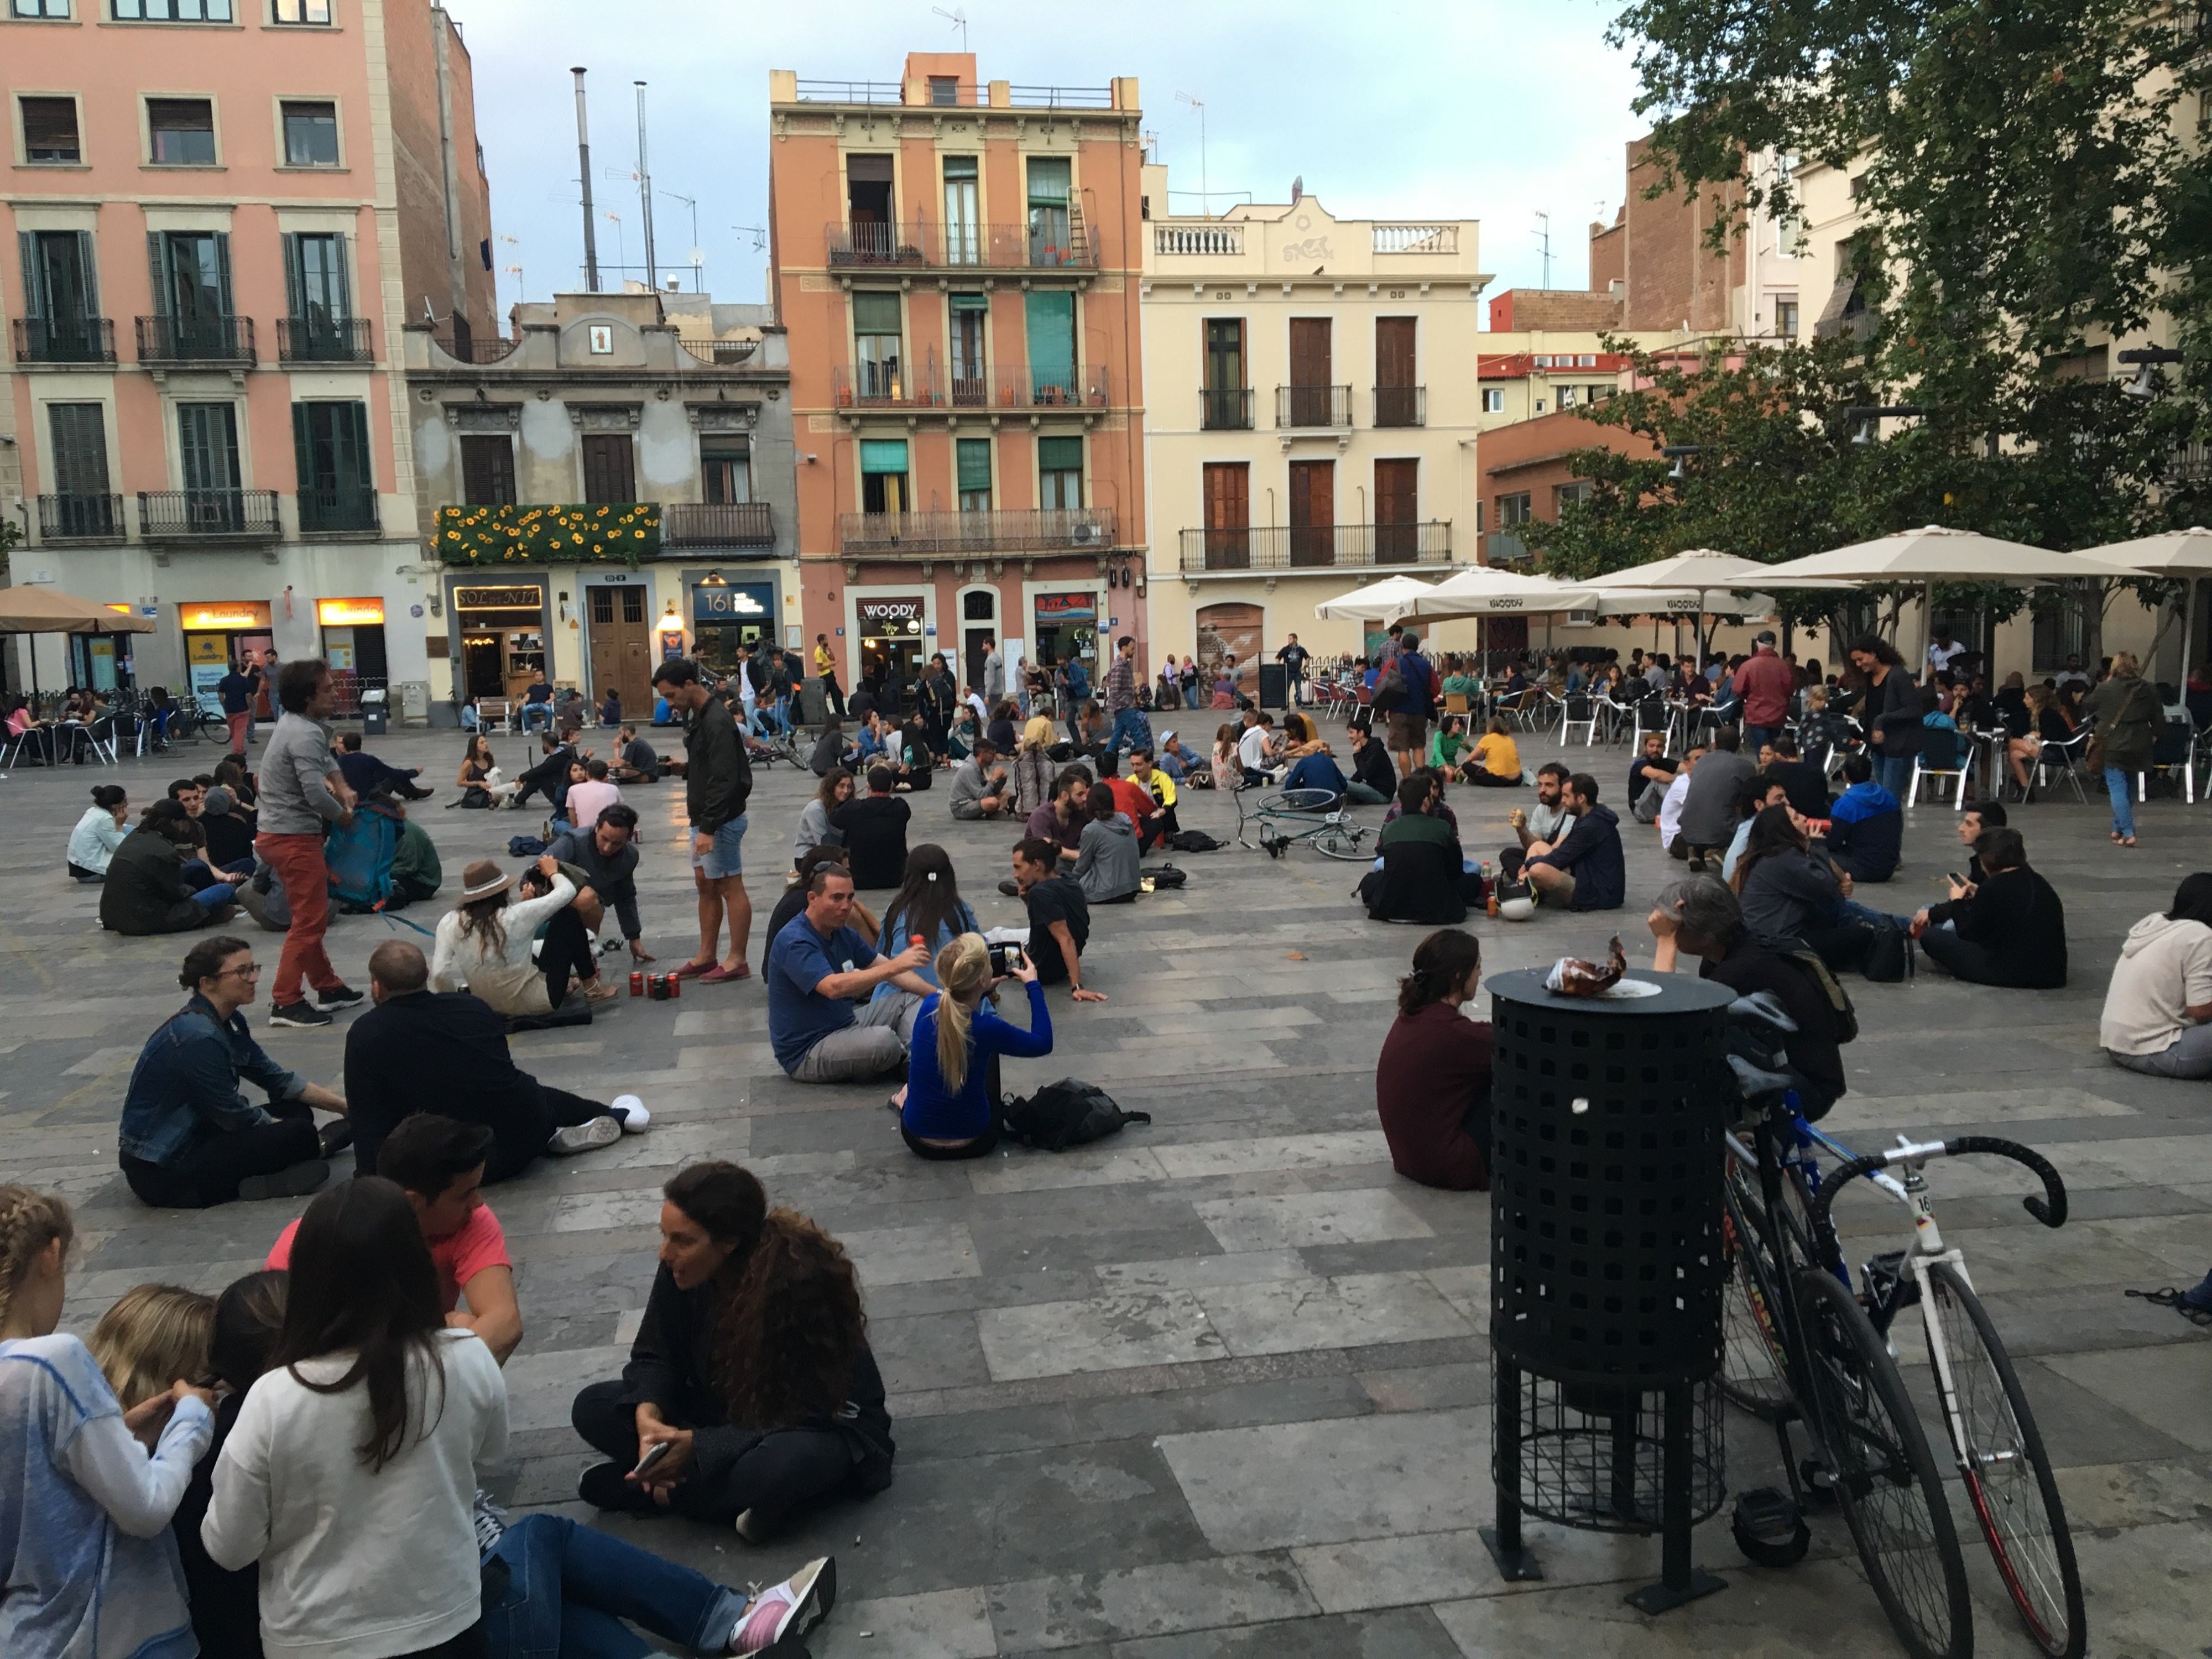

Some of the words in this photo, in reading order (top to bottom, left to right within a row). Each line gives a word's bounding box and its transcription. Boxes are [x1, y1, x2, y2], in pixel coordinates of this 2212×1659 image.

[458, 591, 487, 604] SOL
[503, 590, 538, 603] NIT
[706, 593, 726, 612] 16
[1489, 598, 1524, 608] WOODY
[864, 604, 917, 617] WOODY
[1667, 599, 1700, 609] WOODY
[212, 608, 259, 621] Laundry
[1918, 1196, 1931, 1213] 16
